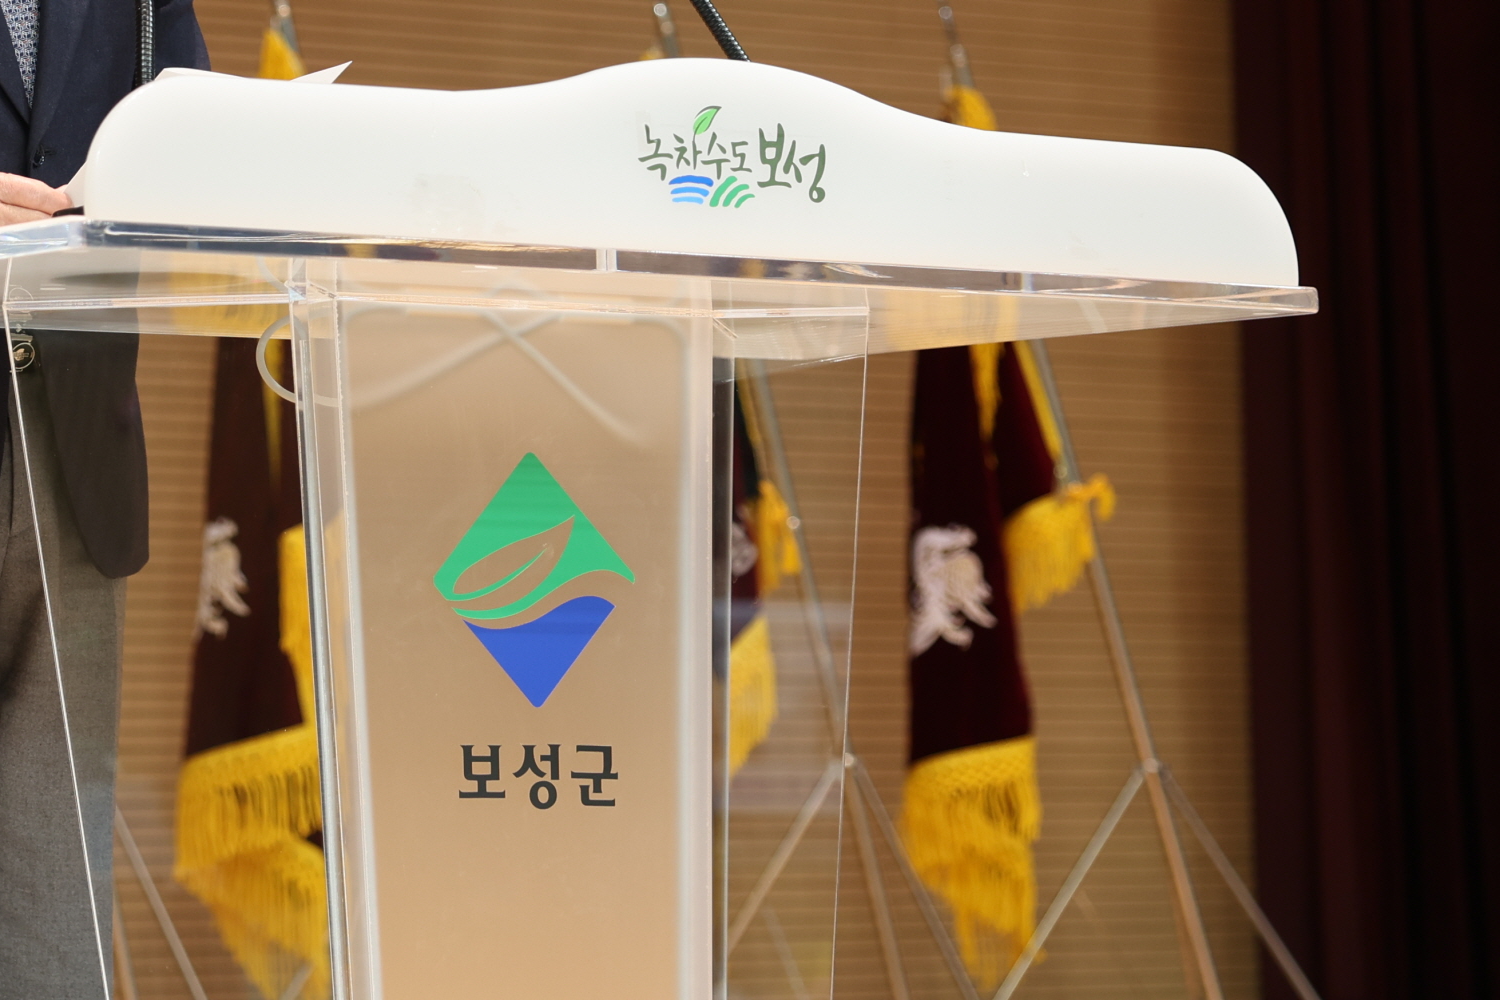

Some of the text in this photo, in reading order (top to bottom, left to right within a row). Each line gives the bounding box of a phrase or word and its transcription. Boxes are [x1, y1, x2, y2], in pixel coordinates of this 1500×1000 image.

[638, 122, 826, 203] 녹차수도 보성
[458, 743, 618, 810] 보성군
